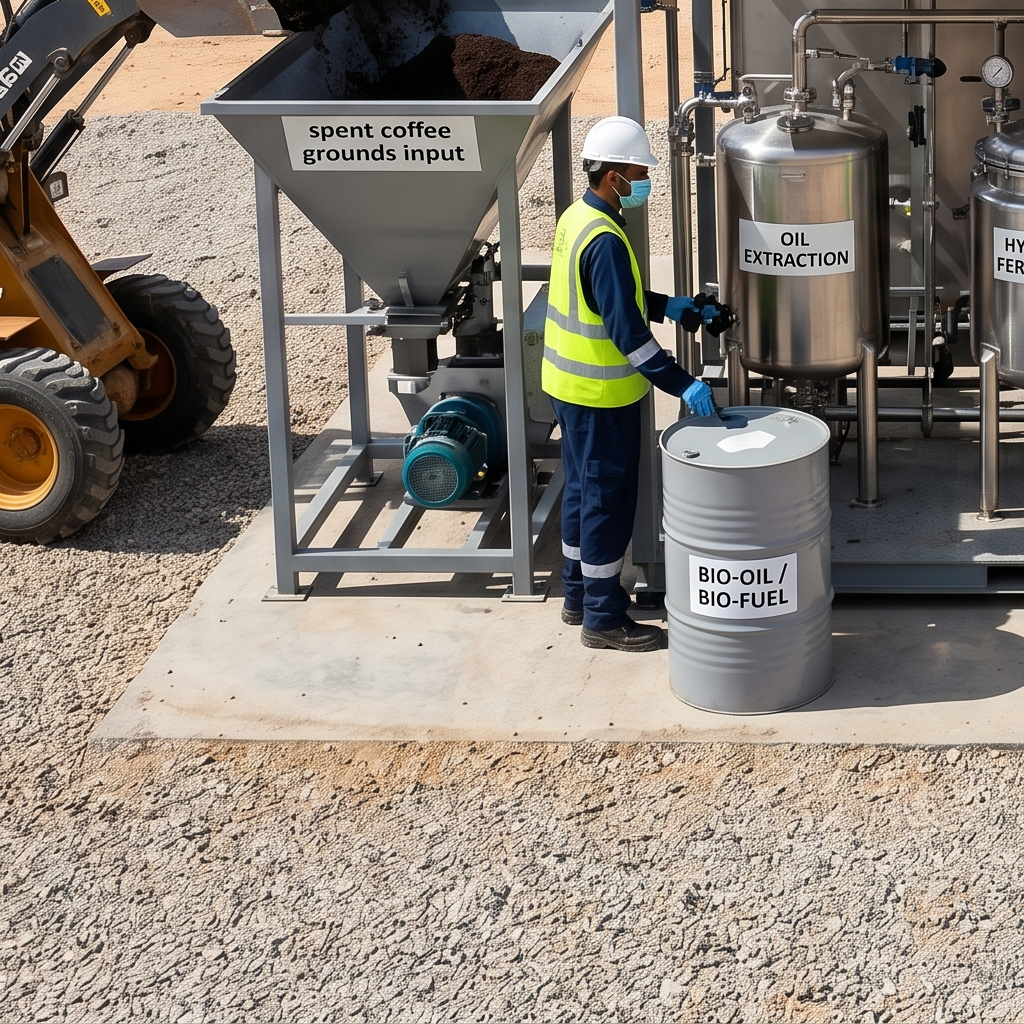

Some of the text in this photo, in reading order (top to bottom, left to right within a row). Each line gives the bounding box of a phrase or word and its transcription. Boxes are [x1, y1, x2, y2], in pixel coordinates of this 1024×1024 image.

[308, 120, 451, 142] spent coffee
[302, 143, 466, 166] grounds input
[780, 231, 810, 247] OIL
[744, 249, 849, 268] EXTRACTION
[698, 562, 788, 586] BIO-OIL /
[698, 588, 789, 609] BIO-FUEL
